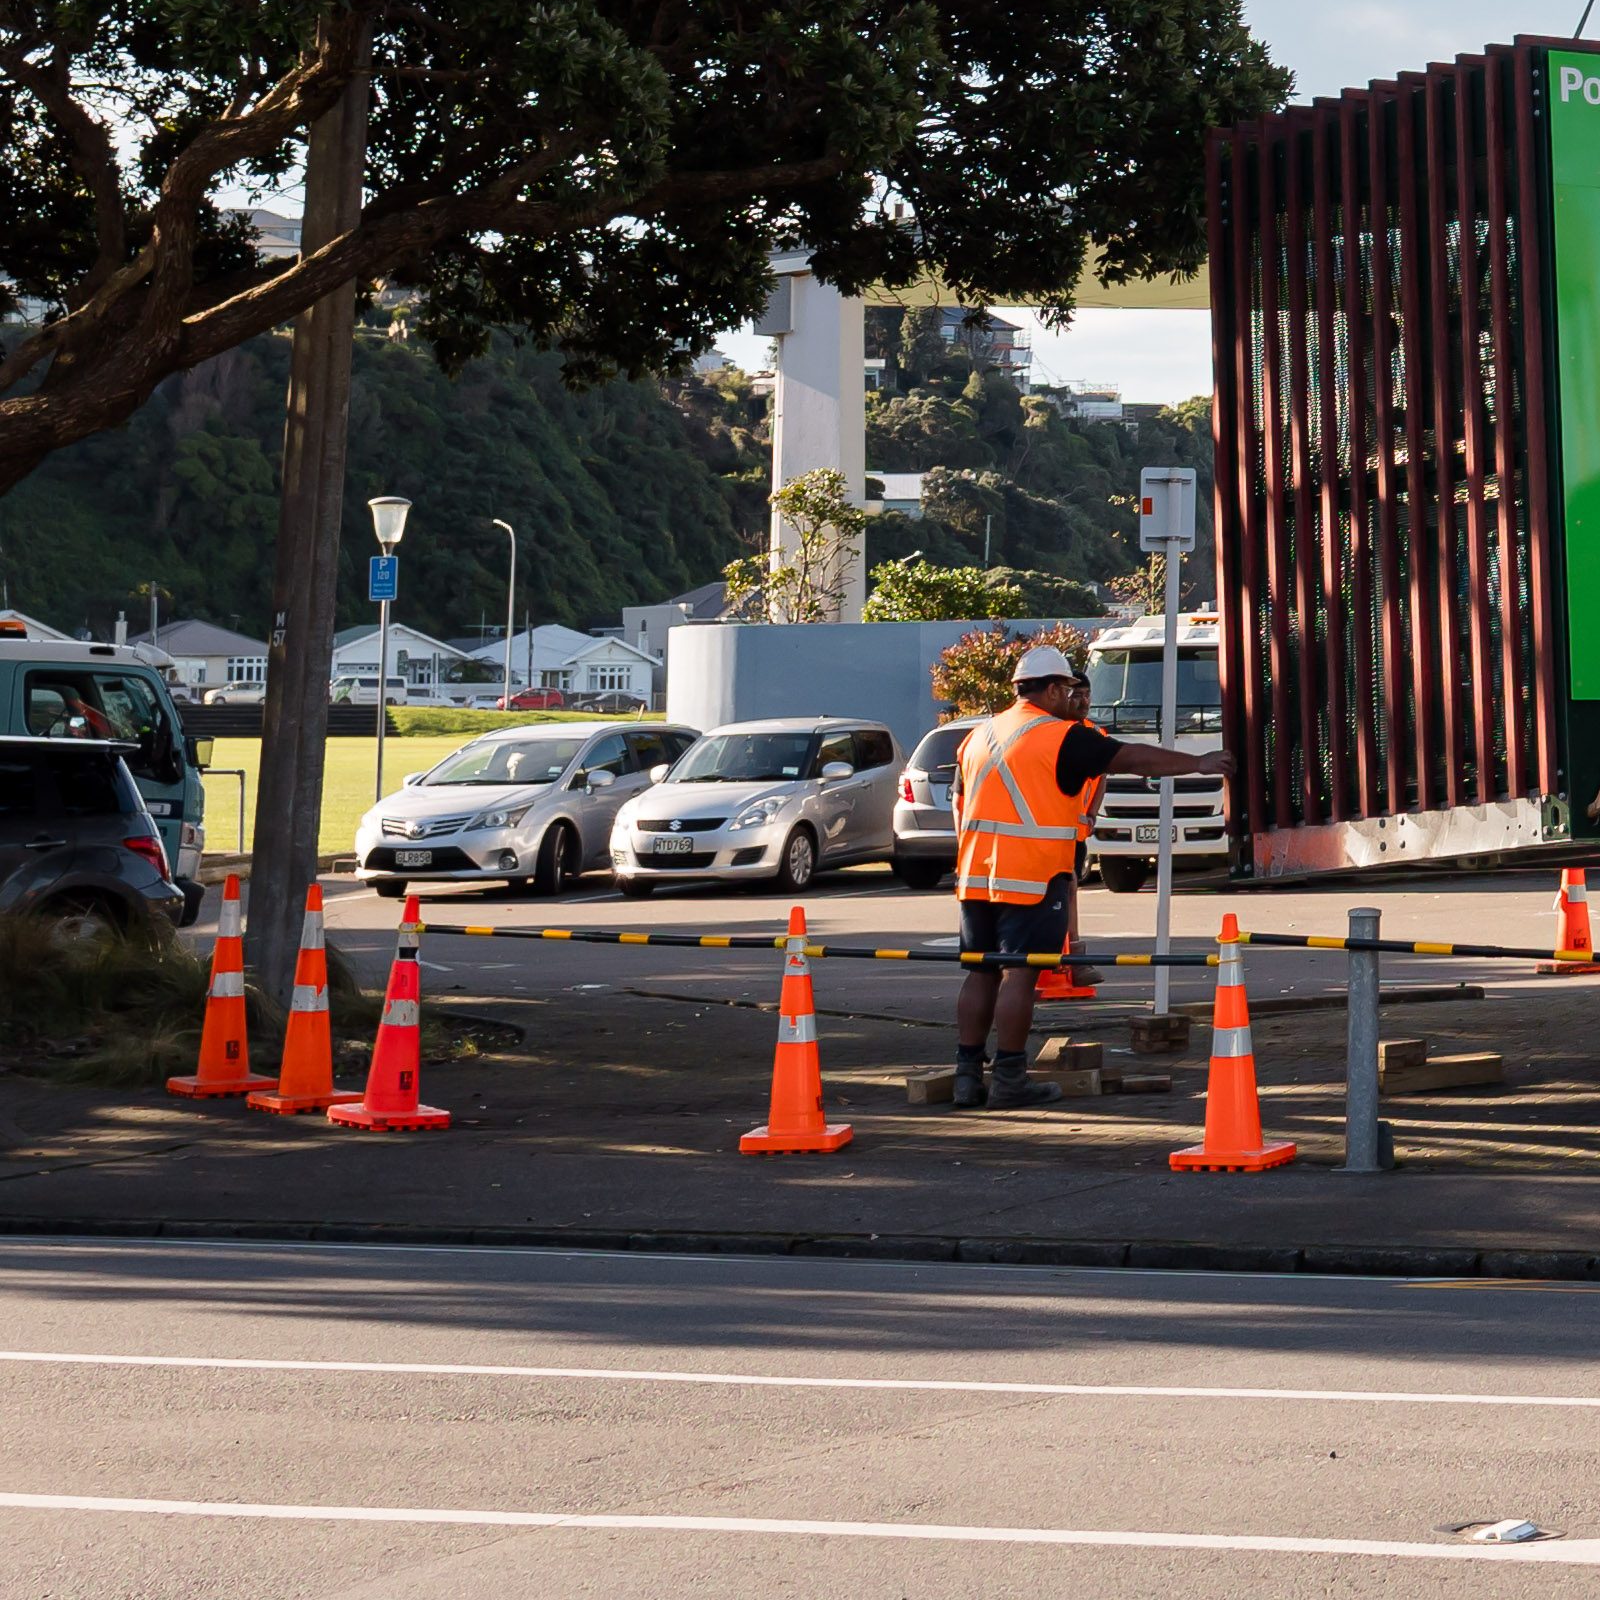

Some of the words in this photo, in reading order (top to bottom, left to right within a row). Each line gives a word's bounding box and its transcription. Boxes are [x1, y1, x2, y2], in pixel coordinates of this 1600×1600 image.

[379, 558, 388, 570] P
[276, 611, 286, 627] M
[273, 630, 287, 648] 57
